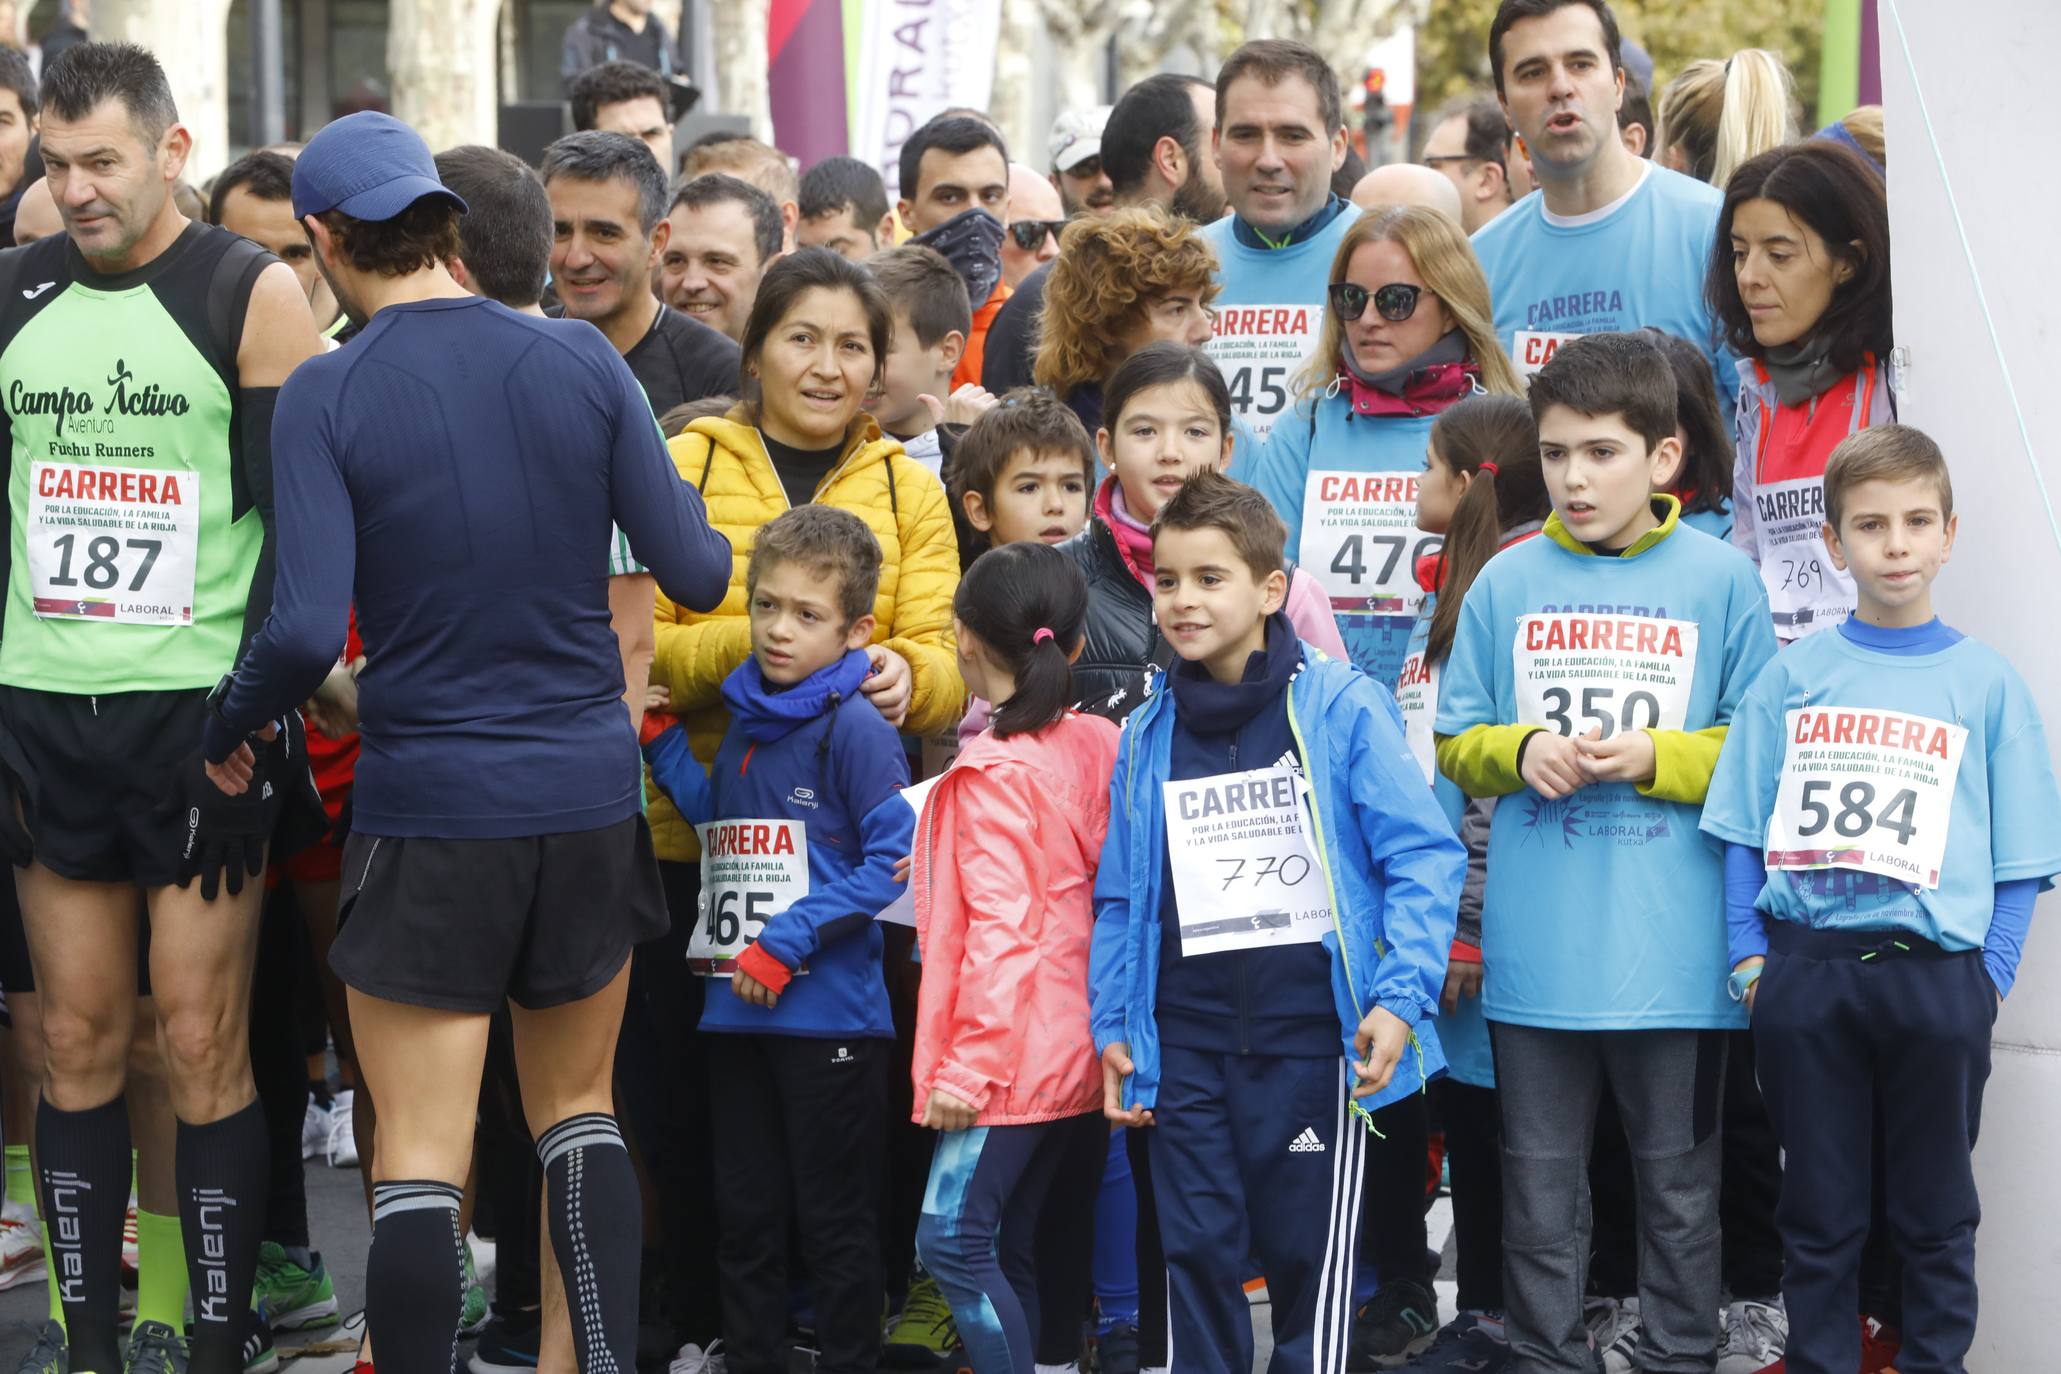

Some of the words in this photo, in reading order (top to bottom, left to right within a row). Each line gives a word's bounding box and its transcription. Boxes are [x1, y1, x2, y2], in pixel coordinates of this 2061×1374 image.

[1527, 290, 1623, 325] CARRERA
[1211, 309, 1308, 336] ARRERA
[10, 379, 94, 438] Campo
[104, 368, 190, 417] Activo
[67, 414, 115, 435] Aventura
[49, 442, 91, 457] Fuchu
[95, 443, 155, 458] Runners
[38, 467, 182, 505] CARRERA
[1320, 476, 1420, 502] CARRE
[45, 505, 60, 513] POR
[62, 506, 71, 514] LA
[123, 510, 134, 518] LA
[136, 510, 170, 520] FAMILIA
[1756, 486, 1825, 522] CARRER
[57, 517, 76, 526] VIDA
[78, 518, 123, 528] SALUDABLE
[125, 521, 135, 529] DE
[138, 521, 148, 530] LA
[151, 522, 177, 532] RIOJA
[1361, 519, 1408, 527] SALUDABLE
[49, 534, 163, 592] 187
[1781, 559, 1823, 593] 769
[121, 603, 174, 615] LABORAL
[1526, 618, 1684, 658] CARRERA
[1528, 671, 1534, 679] Y
[1535, 671, 1545, 679] LA
[1546, 670, 1566, 679] VIDA
[1568, 669, 1621, 679] SALUDABLE
[1623, 671, 1634, 680] DE
[1636, 672, 1648, 682] LA
[1649, 673, 1677, 685] RIOJA
[1534, 658, 1550, 667] POR
[1552, 658, 1563, 666] LA
[1620, 658, 1632, 667] LA
[1635, 660, 1671, 672] FAMILIA
[1542, 686, 1661, 741] 350
[1795, 712, 1948, 760] CARRERA
[1798, 751, 1812, 760] POR
[1814, 751, 1825, 759] LA
[1883, 753, 1895, 763] LA
[1898, 755, 1934, 773] FAMILIA
[1792, 764, 1797, 772] Y
[1798, 763, 1807, 772] LA
[1809, 762, 1828, 771] VIDA
[1831, 764, 1881, 774] SALUDABLE
[1884, 766, 1896, 776] DE
[1899, 769, 1910, 779] LA
[1913, 773, 1939, 787] RIOJA
[1178, 776, 1297, 821] CARRE
[1192, 825, 1210, 835] POR
[1212, 822, 1223, 832] LA
[1280, 814, 1292, 823] LA
[1798, 780, 1919, 846] 584
[707, 825, 795, 858] CARRERA
[1194, 837, 1205, 846] LA
[1208, 833, 1229, 843] VIDA
[1232, 826, 1282, 840] SALUDABLE
[1285, 825, 1296, 834] DE
[1589, 825, 1643, 837] LABORAL
[741, 862, 750, 871] LA
[751, 862, 784, 871] FAMILIA
[1216, 854, 1310, 891] 770
[1870, 851, 1922, 874] LABORAL
[743, 874, 751, 882] DE
[754, 874, 763, 882] LA
[1289, 1143, 1325, 1152] adidas
